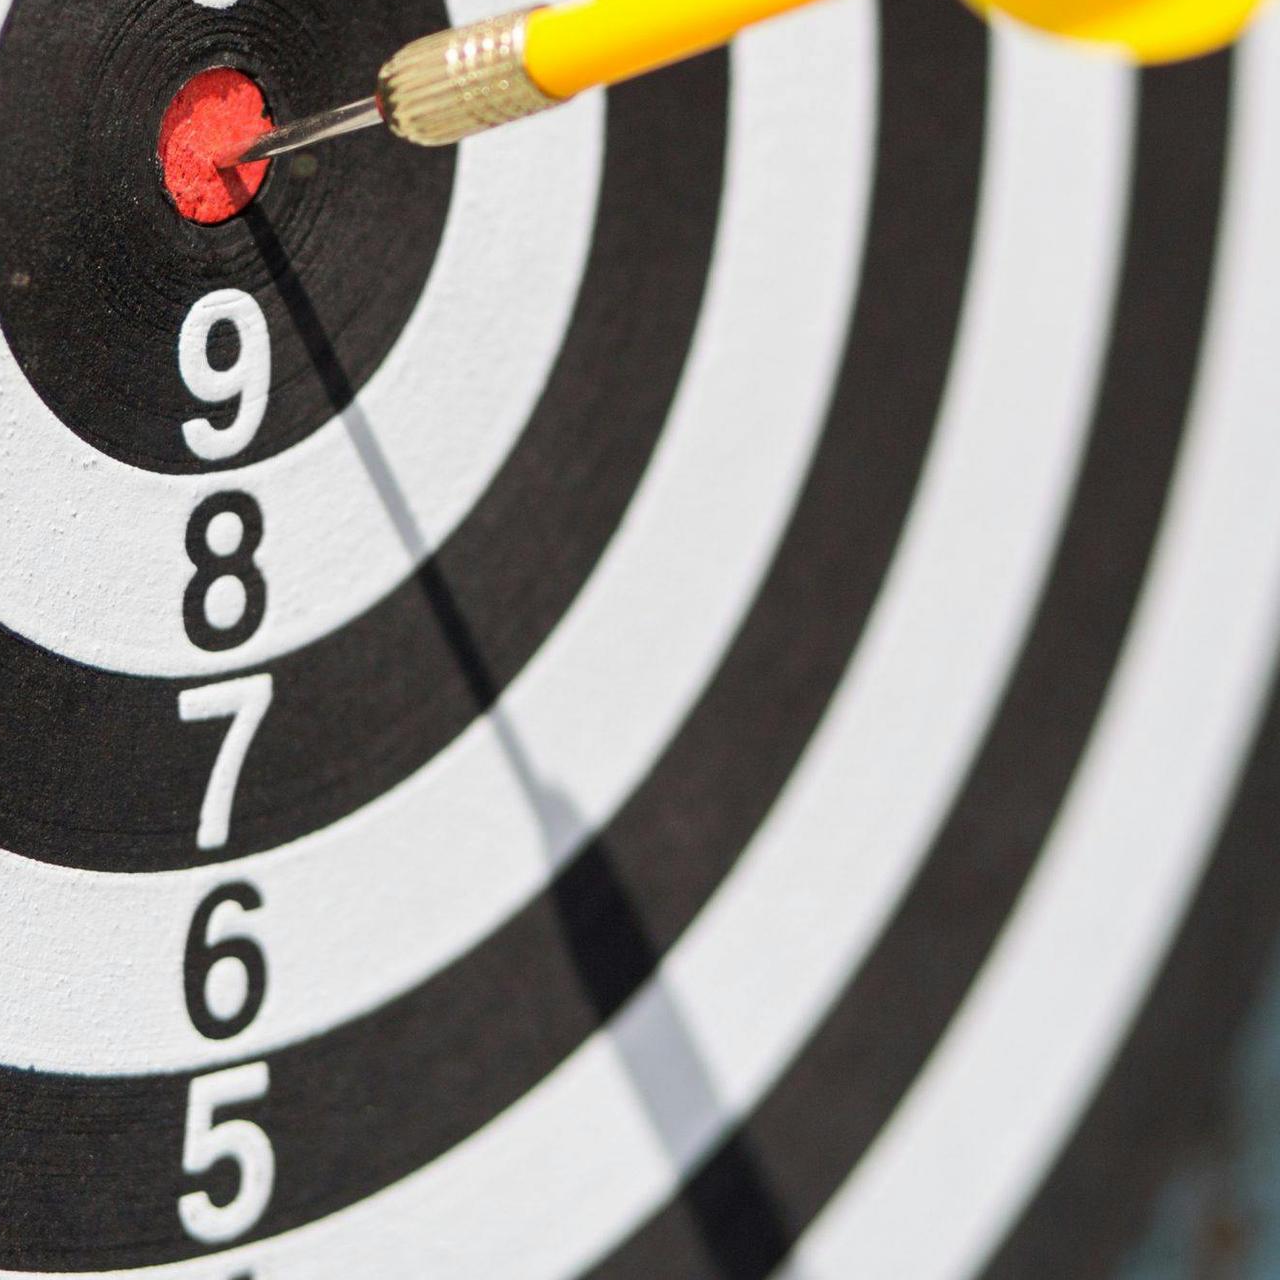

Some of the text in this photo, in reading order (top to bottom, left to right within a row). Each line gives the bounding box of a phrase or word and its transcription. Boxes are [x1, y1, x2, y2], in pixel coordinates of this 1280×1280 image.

[177, 288, 271, 461] 9
[181, 489, 267, 653] 8
[177, 673, 273, 849] 7
[182, 880, 268, 1041] 6
[178, 1061, 274, 1242] 5
